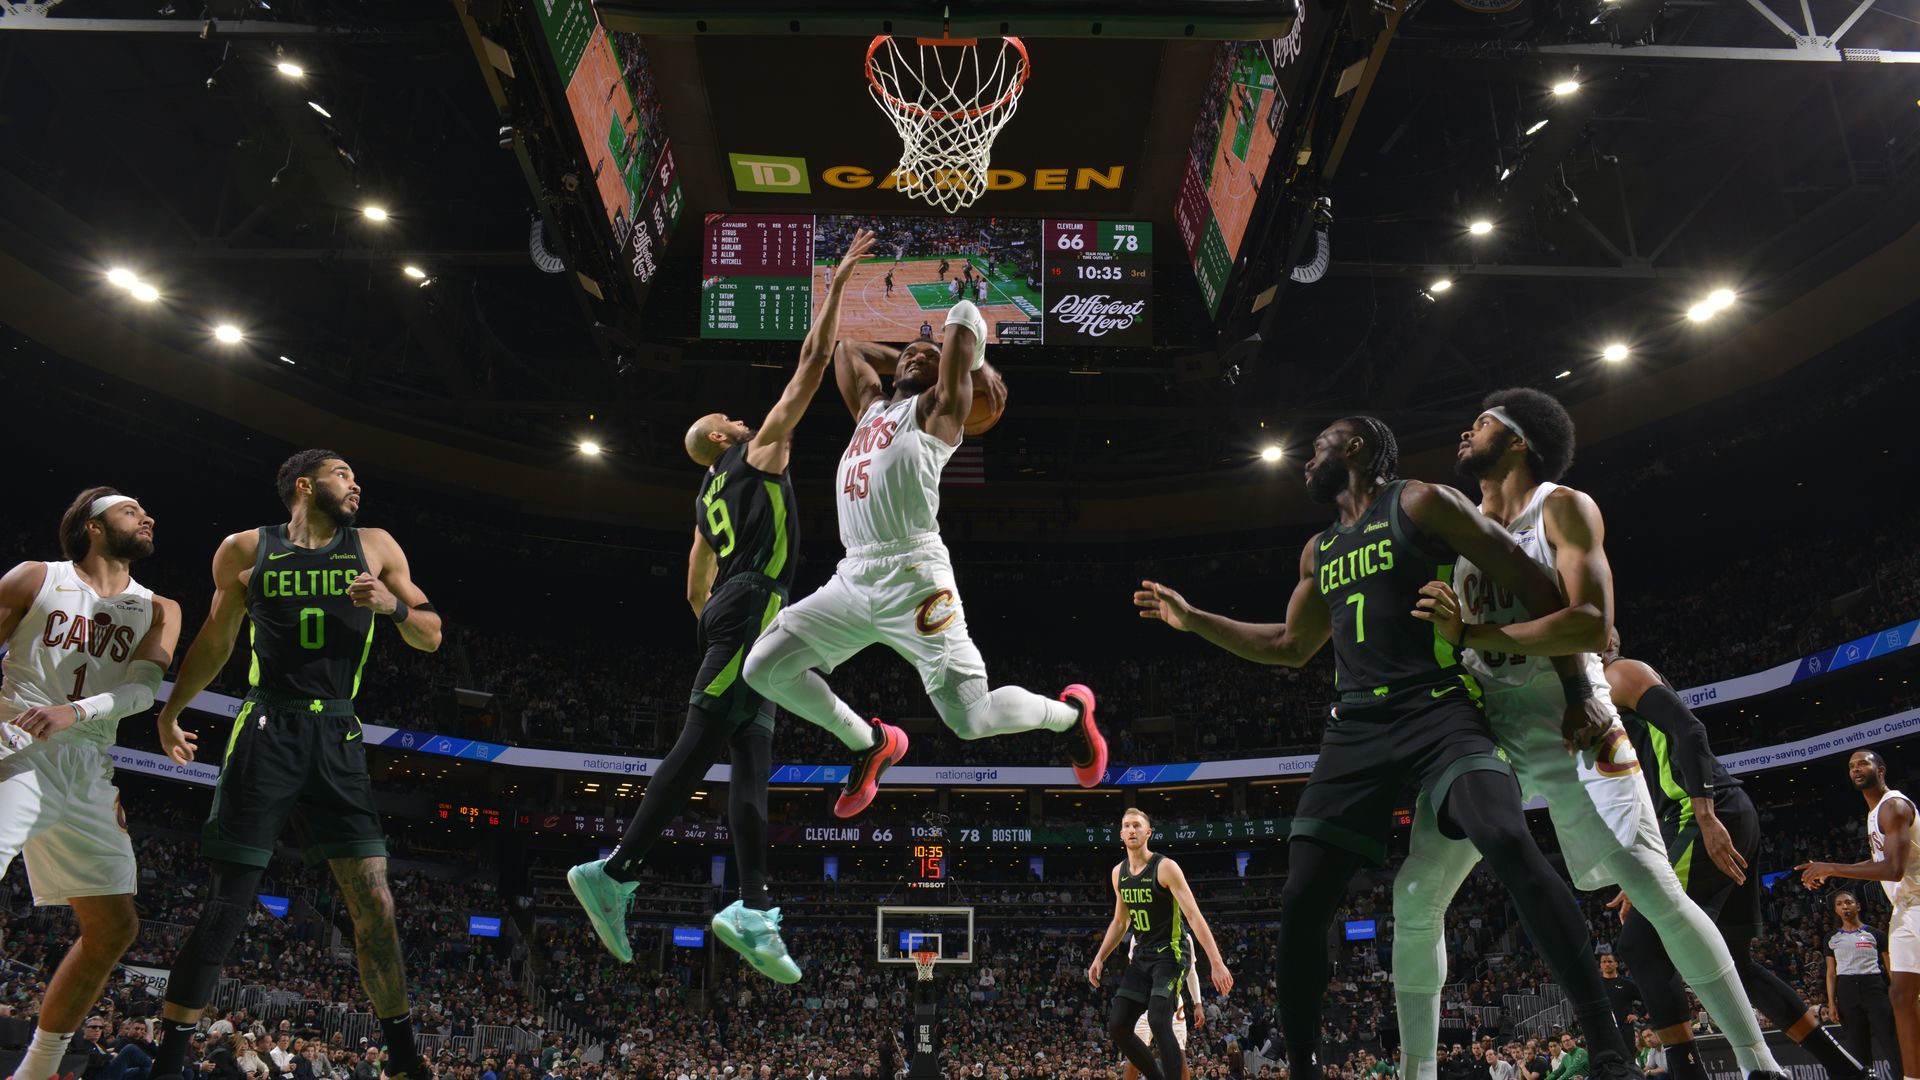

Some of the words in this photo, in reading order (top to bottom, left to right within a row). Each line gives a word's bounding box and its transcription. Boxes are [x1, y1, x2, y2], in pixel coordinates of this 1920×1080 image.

[736, 161, 800, 187] TD
[822, 165, 1125, 191] GARDEN
[633, 220, 656, 276] Different
[1058, 234, 1084, 250] 66
[1113, 235, 1139, 251] 78
[1077, 266, 1122, 280] 10:35
[1131, 269, 1146, 277] 3rd
[1050, 294, 1145, 322] Different
[1078, 314, 1133, 337] Here
[845, 417, 897, 460] AVS
[844, 459, 871, 501] 45
[707, 498, 735, 558] 9
[1364, 521, 1389, 533] Amica
[1321, 539, 1394, 594] CELTICS
[264, 569, 358, 597] CELTICS
[1346, 592, 1364, 643] 7
[43, 610, 134, 663] CAVS
[300, 608, 324, 649] 0
[66, 663, 87, 702] 1
[1739, 747, 1806, 766] energy-saving
[1808, 741, 1831, 755] game
[1833, 738, 1844, 746] on
[1846, 731, 1865, 743] with
[1867, 728, 1882, 737] our
[121, 754, 133, 764] on
[136, 756, 156, 769] with
[158, 764, 173, 772] our
[584, 759, 646, 772] nationalgrid
[936, 769, 997, 781] nationalgrid
[460, 806, 478, 816] 10:35
[489, 816, 499, 825] 66
[1401, 816, 1410, 824] 66
[685, 830, 706, 838] 24/47
[806, 828, 860, 841] CLEVELAND
[872, 829, 892, 842] 66
[960, 830, 980, 842] 78
[992, 829, 1031, 842] BOSTON
[914, 846, 943, 858] 10:35
[921, 858, 940, 878] 15
[1121, 888, 1152, 903] CELTICS
[1130, 909, 1150, 931] 30
[920, 1025, 930, 1033] GET
[920, 1034, 930, 1042] THE
[922, 1043, 932, 1054] App
